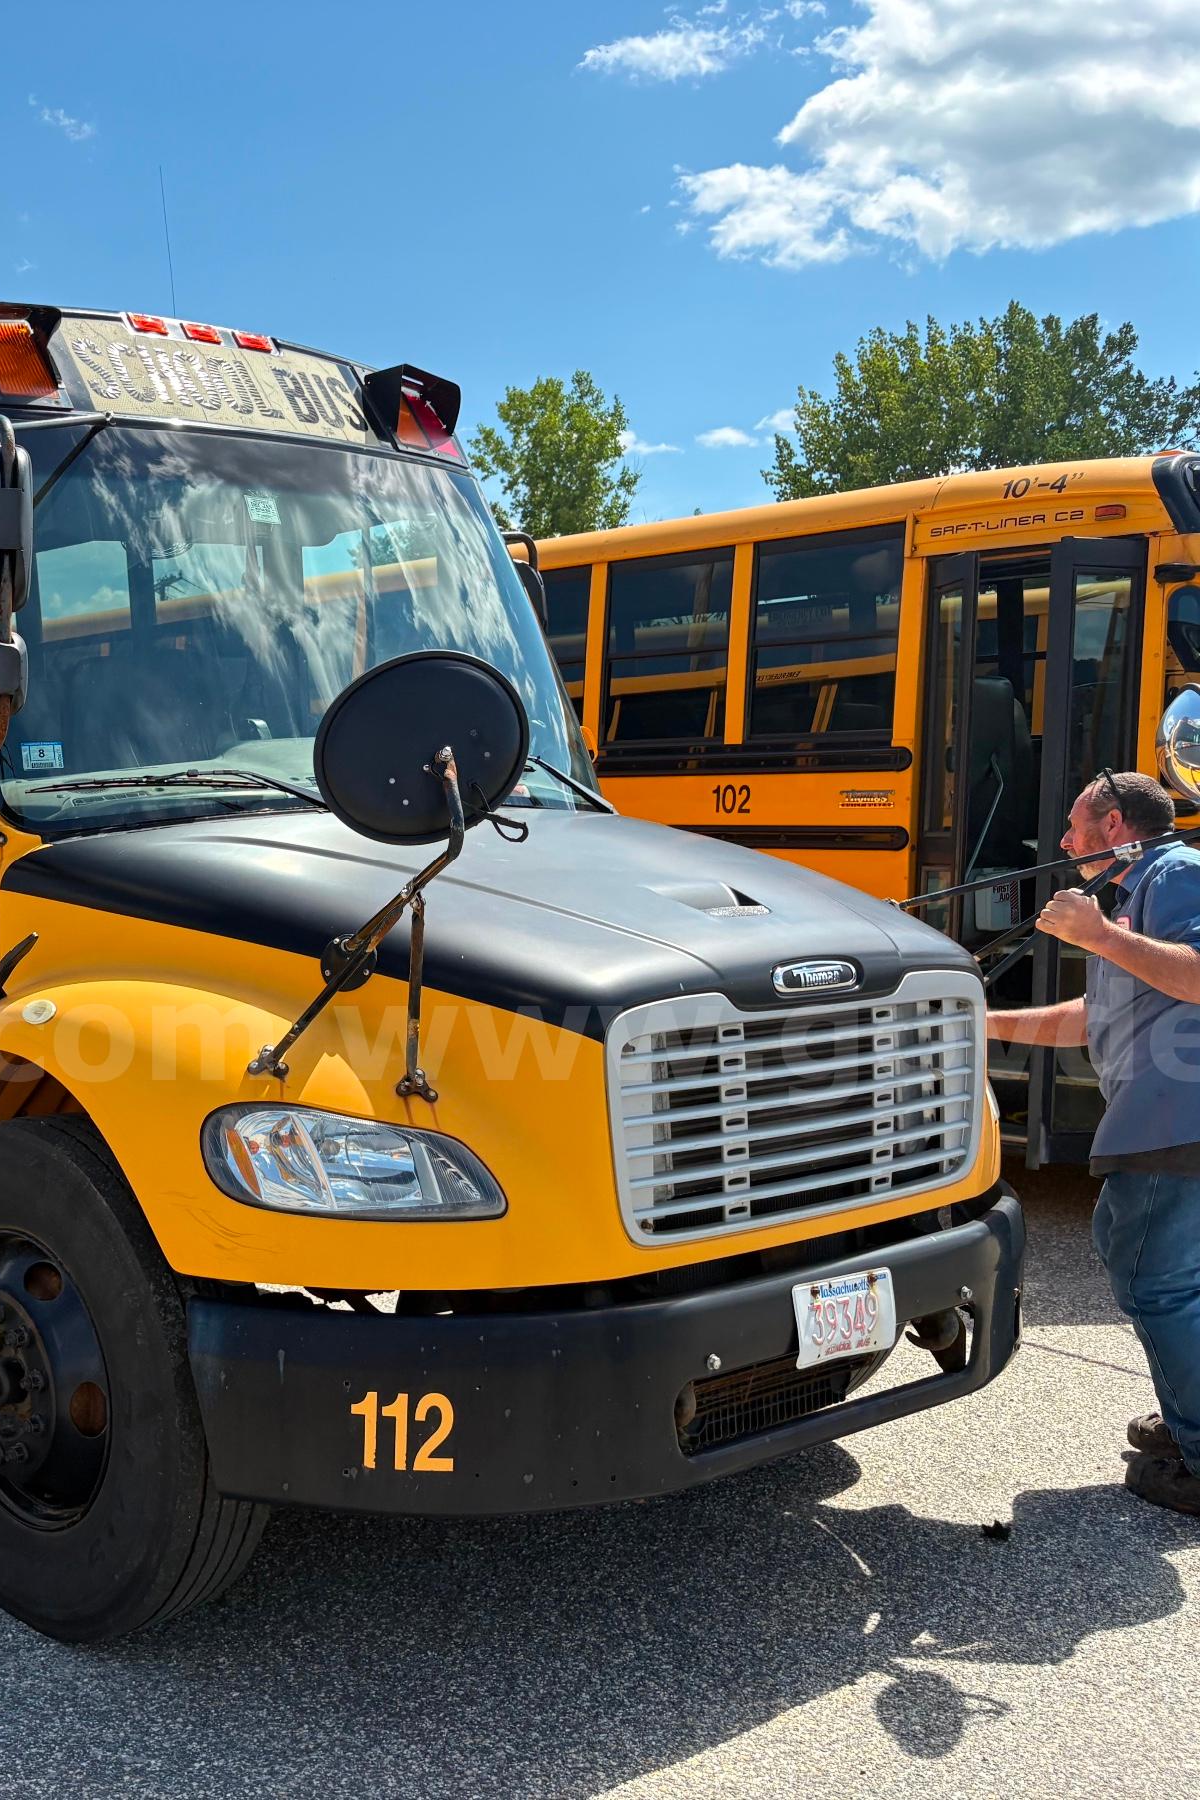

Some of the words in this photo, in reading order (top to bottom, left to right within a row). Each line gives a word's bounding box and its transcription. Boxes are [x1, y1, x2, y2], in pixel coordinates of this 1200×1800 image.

[71, 336, 286, 420] SCHOOL
[272, 364, 370, 432] BUS
[930, 514, 1046, 537] SAF-T-LINER
[1054, 510, 1084, 521] C2
[38, 749, 46, 758] 8
[712, 784, 751, 814] 102
[992, 884, 1010, 893] FIRST
[999, 892, 1010, 901] AID
[808, 1293, 879, 1346] 39349
[350, 1390, 455, 1473] 112
